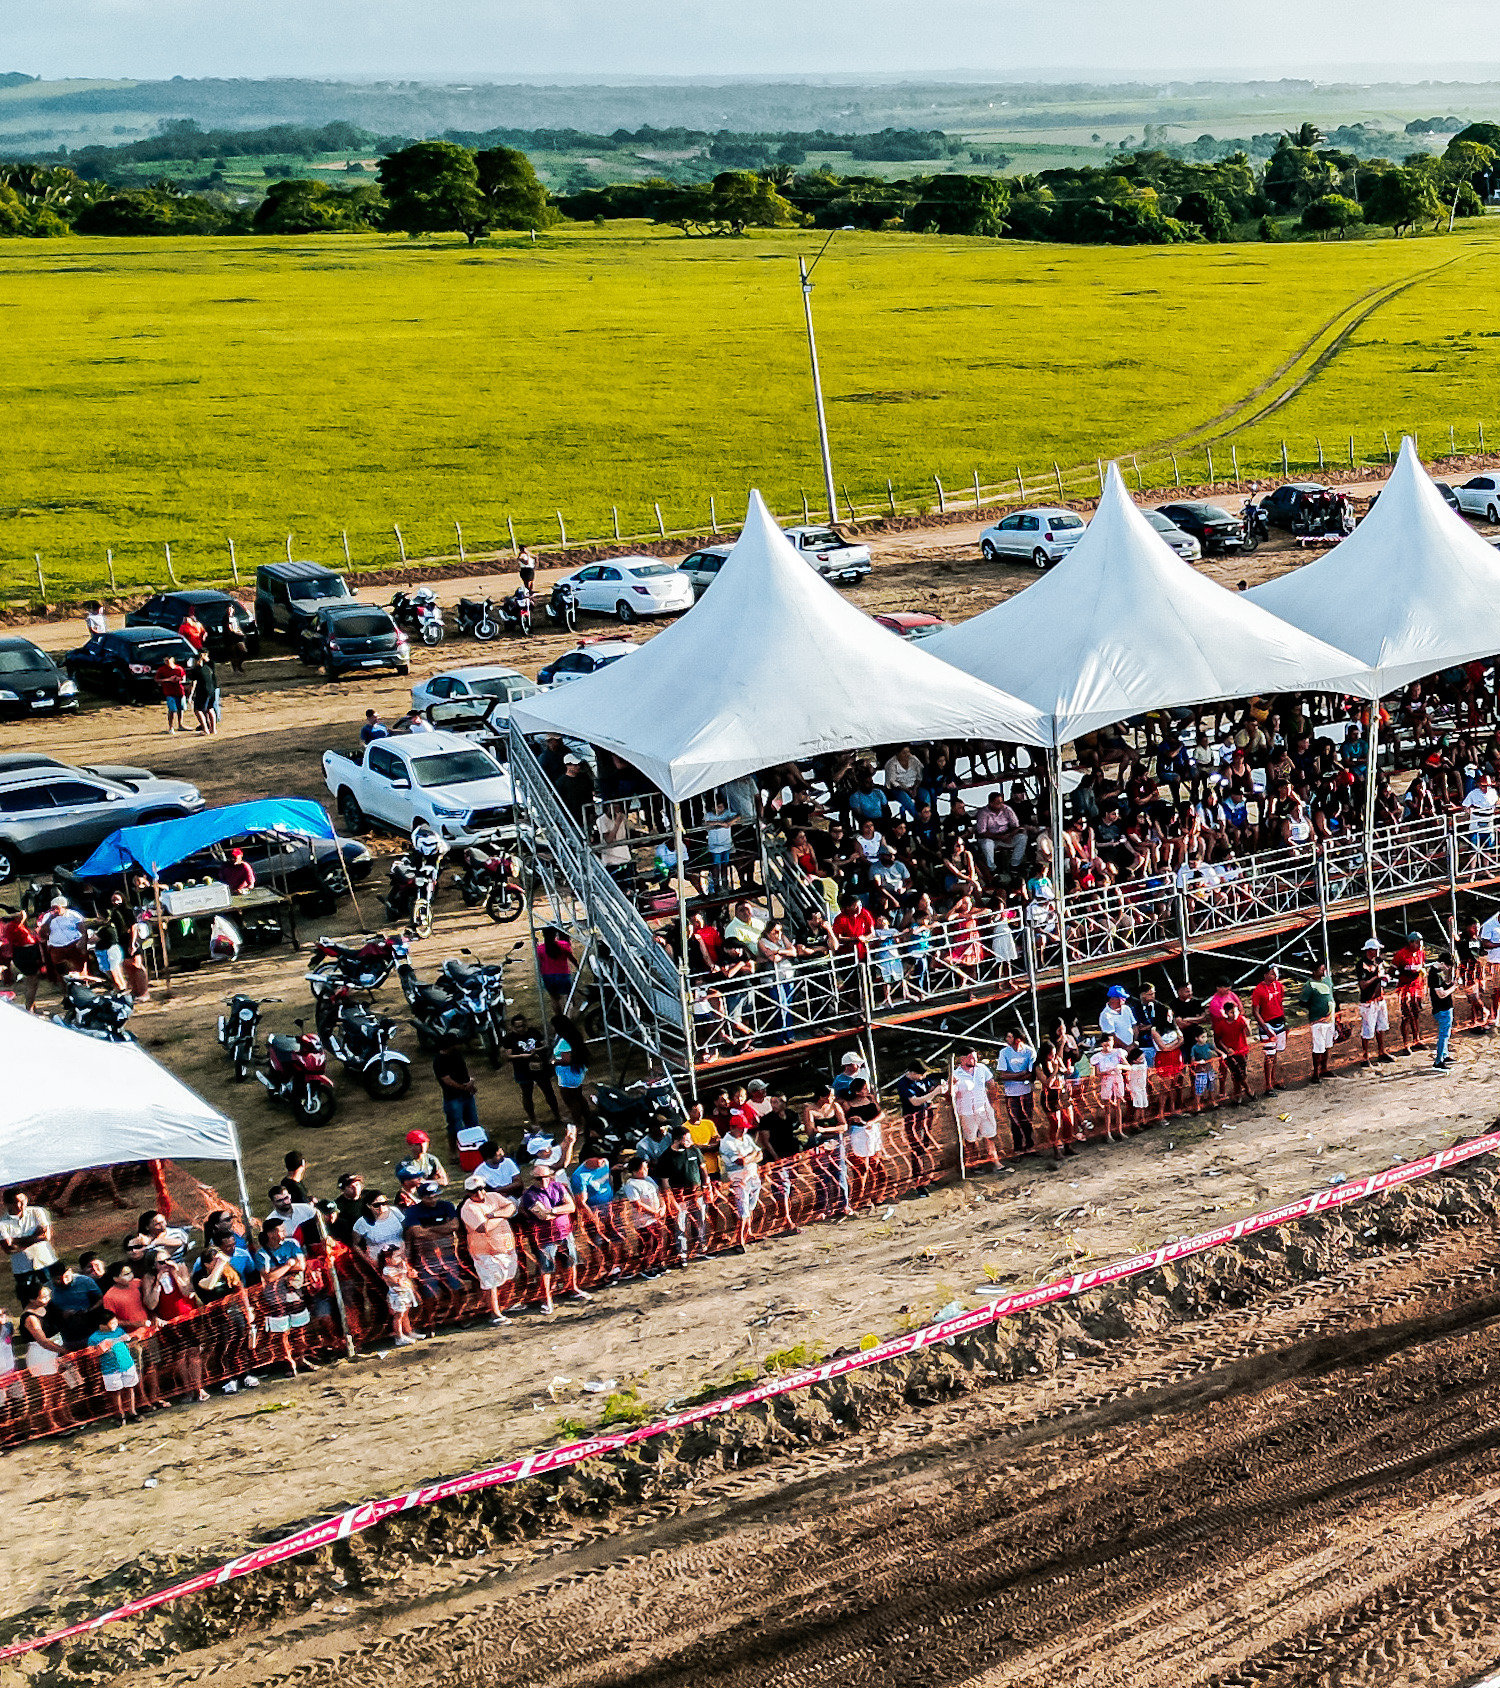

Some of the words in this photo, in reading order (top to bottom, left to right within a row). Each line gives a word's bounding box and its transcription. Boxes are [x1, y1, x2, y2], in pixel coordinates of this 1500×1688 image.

[1257, 1204, 1306, 1226] HONDA
[1181, 1230, 1234, 1251] HONDA
[1100, 1257, 1154, 1279] HONDA
[1013, 1284, 1069, 1307] HONDA
[754, 1371, 817, 1398] HONDA
